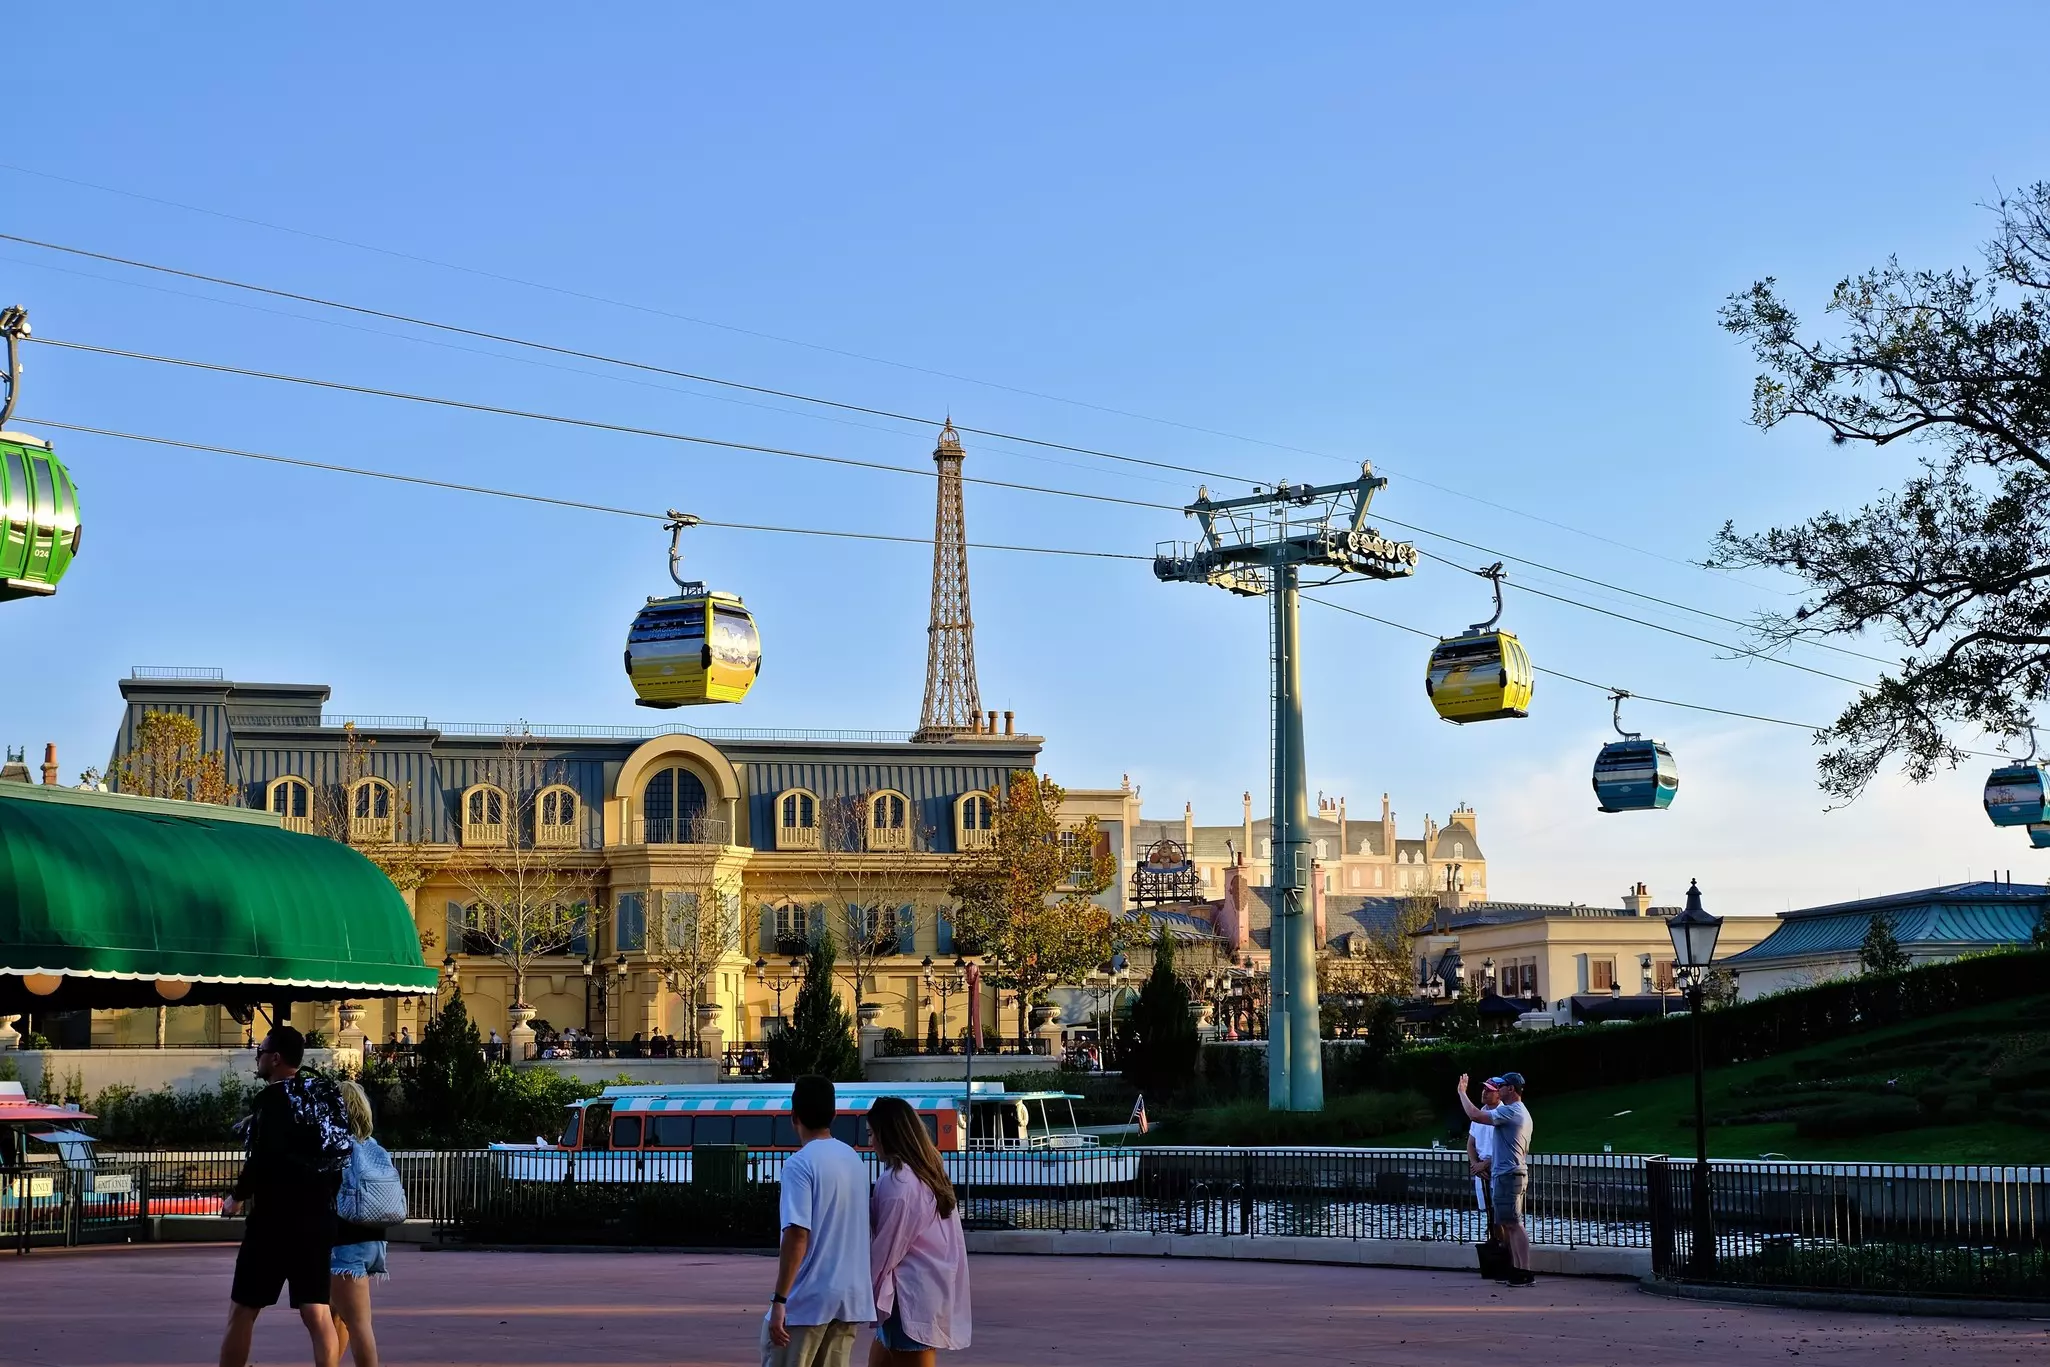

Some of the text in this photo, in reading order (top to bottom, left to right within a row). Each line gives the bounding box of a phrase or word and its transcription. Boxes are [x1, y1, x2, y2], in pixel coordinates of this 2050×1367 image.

[34, 549, 49, 558] 024
[32, 1182, 50, 1192] ONLY
[112, 1179, 128, 1188] ONLY
